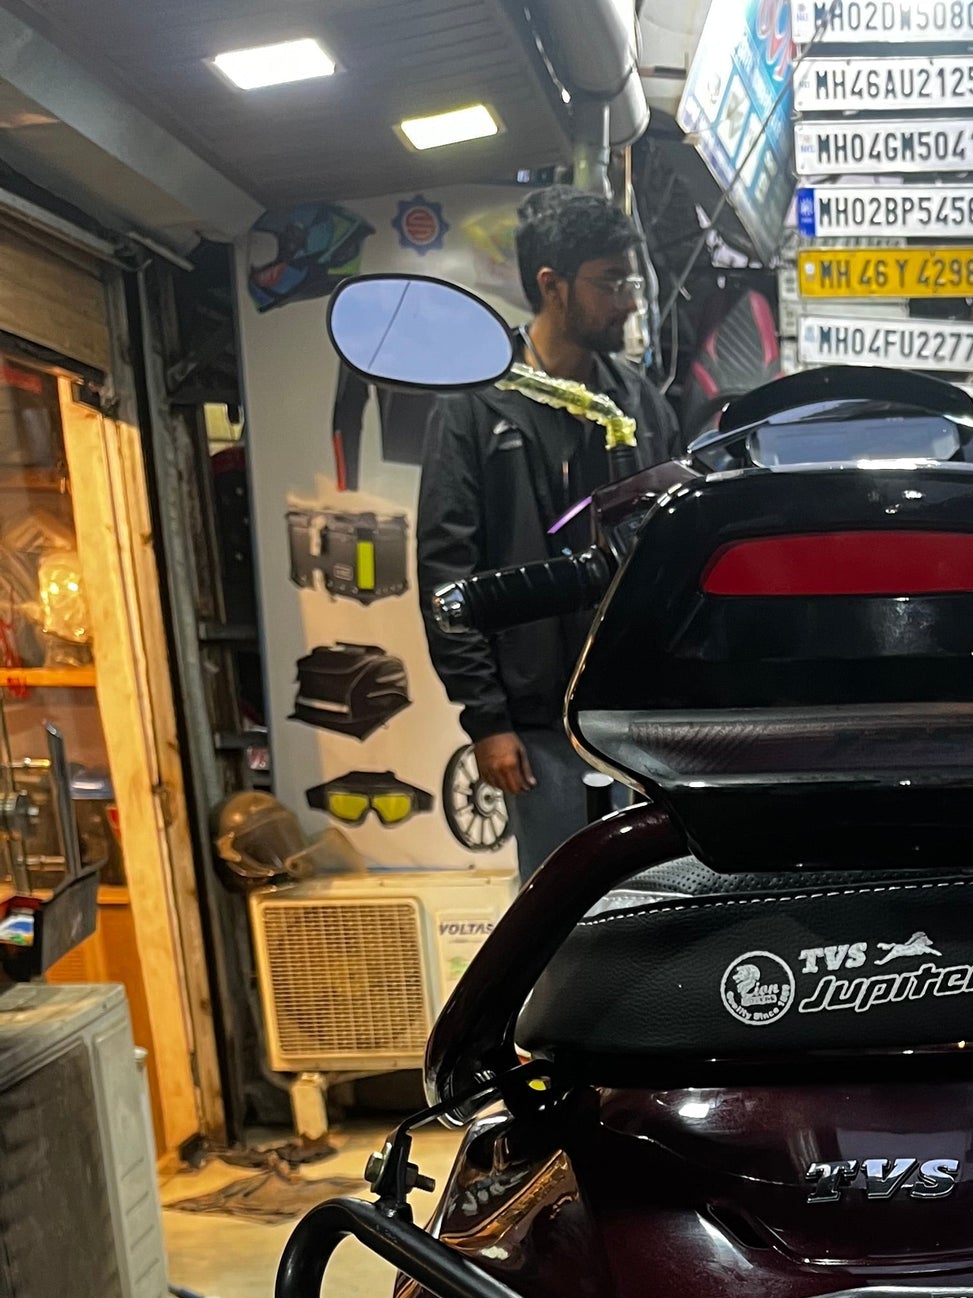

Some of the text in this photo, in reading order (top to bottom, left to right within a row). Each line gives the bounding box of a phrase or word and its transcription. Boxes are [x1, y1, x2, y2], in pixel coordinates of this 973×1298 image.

[820, 260, 850, 288] MH
[860, 259, 888, 286] 46
[896, 260, 908, 287] Y
[439, 922, 494, 936] VOLTAS
[799, 942, 867, 974] TVS
[805, 1158, 960, 1204] TVS
